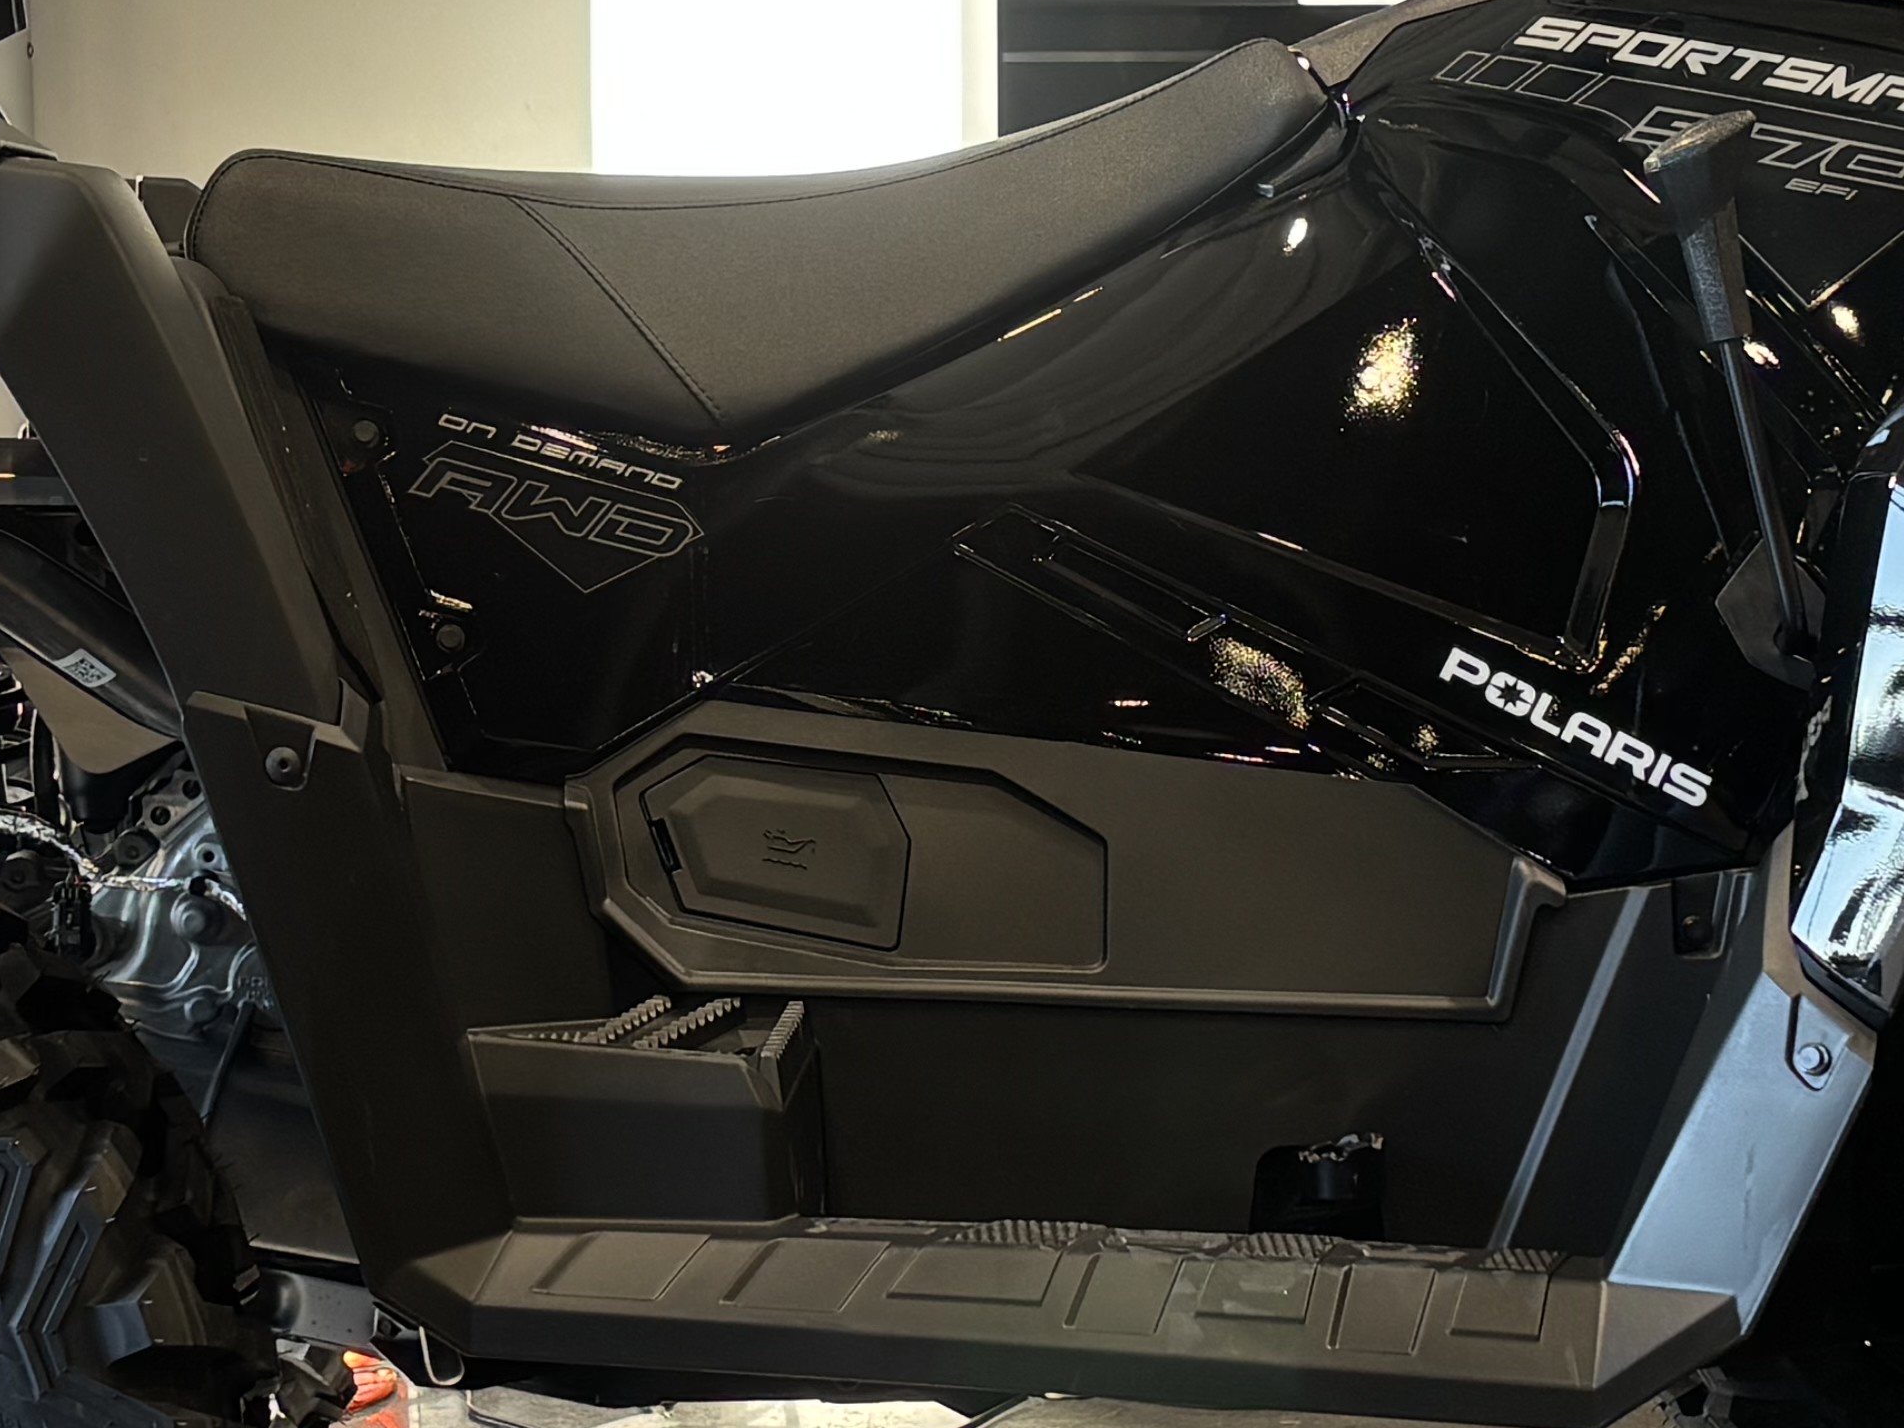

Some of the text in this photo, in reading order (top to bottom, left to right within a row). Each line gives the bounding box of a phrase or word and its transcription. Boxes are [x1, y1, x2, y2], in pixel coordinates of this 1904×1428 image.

[1785, 177, 1860, 202] EFI
[510, 434, 685, 491] DEMAND
[409, 457, 696, 559] AWD
[1438, 646, 1713, 807] POLARIS
